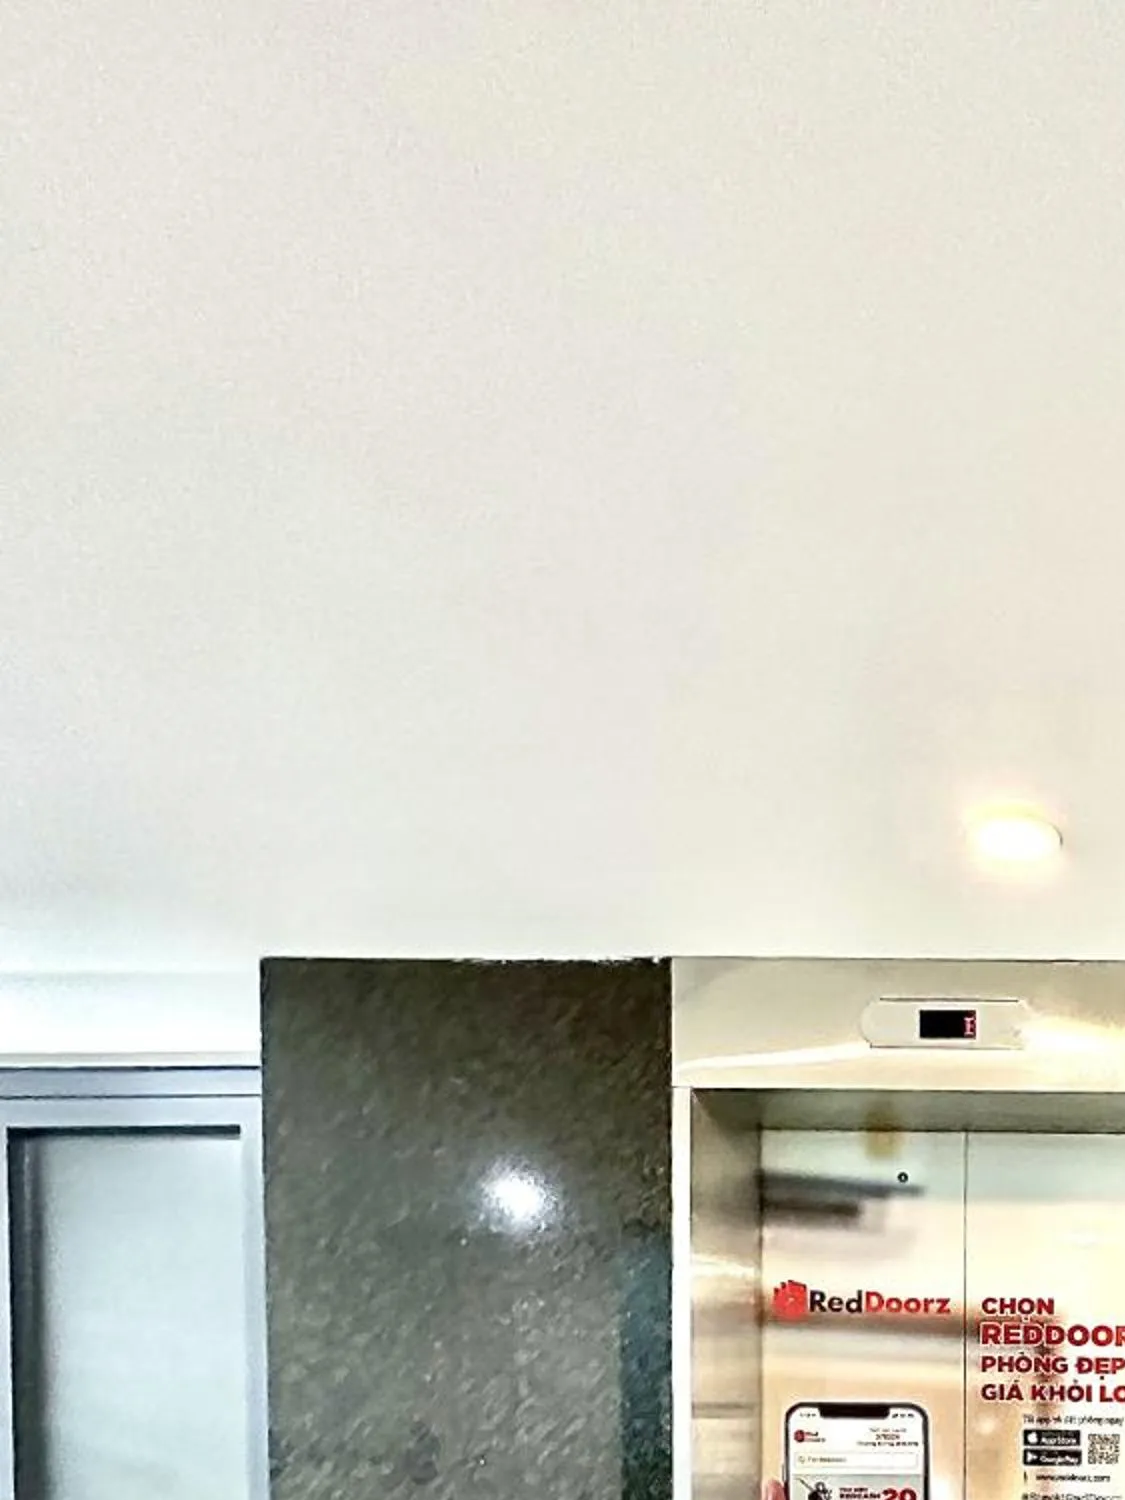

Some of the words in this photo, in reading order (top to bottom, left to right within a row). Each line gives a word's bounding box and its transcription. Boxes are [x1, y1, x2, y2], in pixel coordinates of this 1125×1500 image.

[809, 1289, 951, 1313] RedDoorz
[981, 1297, 1055, 1321] CHỌN
[980, 1351, 1069, 1374] PHÒNG
[981, 1378, 1024, 1401] GIÁ
